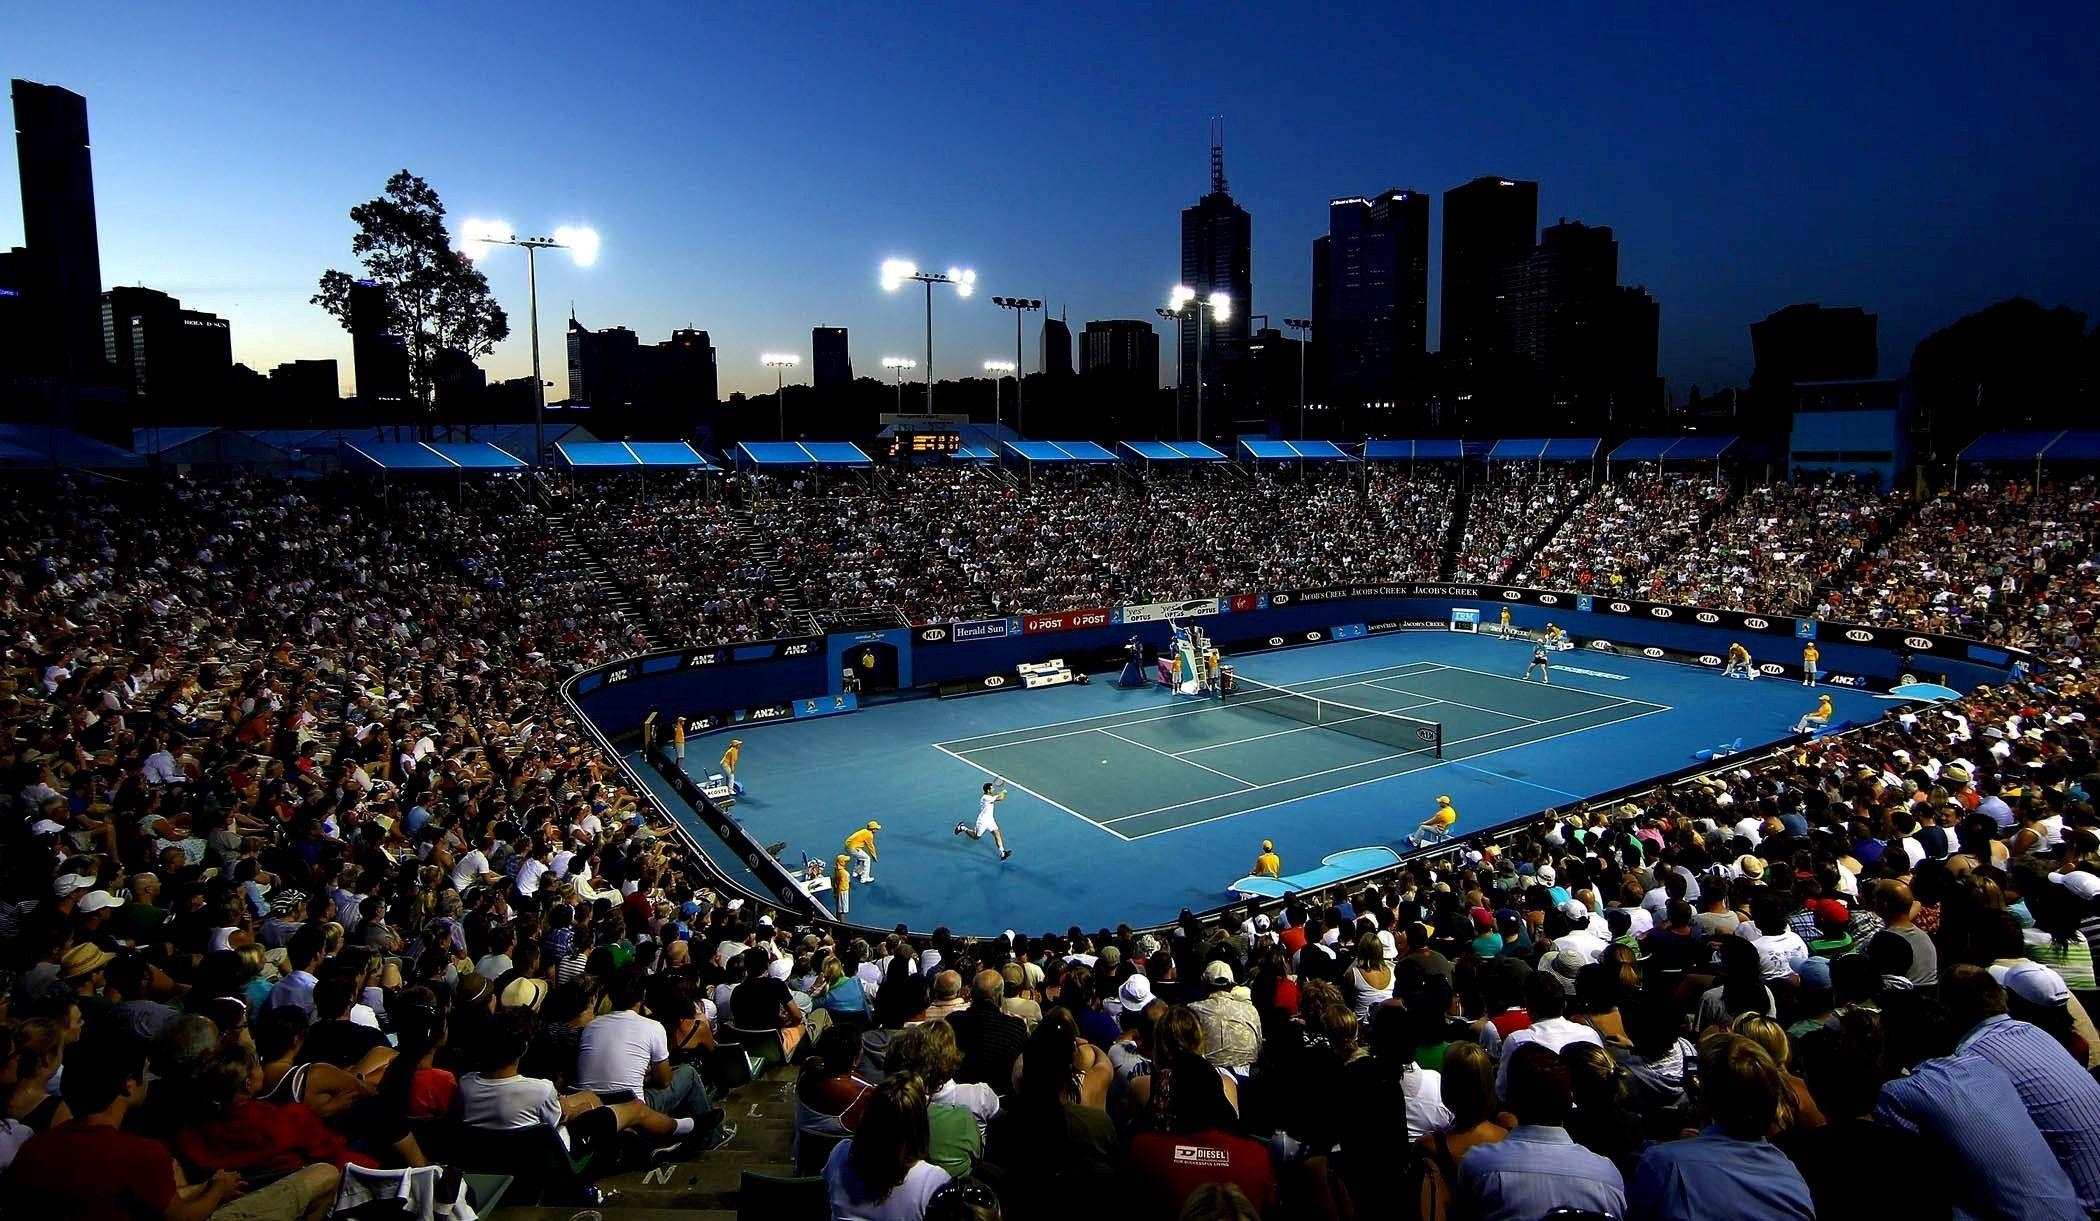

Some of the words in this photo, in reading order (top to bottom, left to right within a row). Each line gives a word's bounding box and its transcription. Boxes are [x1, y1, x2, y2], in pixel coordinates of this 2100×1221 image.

[1412, 585, 1448, 595] JACOB'S
[1448, 587, 1479, 596] CREEK
[1504, 591, 1520, 599] KIA
[1541, 594, 1556, 603] KIA
[1197, 607, 1216, 615] OPTUS
[1612, 602, 1630, 612] KIA
[1653, 607, 1672, 617] KIA
[1082, 615, 1105, 625] POST
[1130, 614, 1151, 622] OPTUS
[1697, 612, 1718, 622] KIA
[1039, 619, 1063, 630] POST
[1745, 618, 1767, 628] KIA
[925, 630, 943, 640] KIA
[956, 627, 986, 637] Herald
[987, 624, 1004, 634] Sun
[1847, 629, 1873, 640] KIA
[1905, 636, 1932, 648] KIA
[784, 644, 808, 656] ANZ
[1645, 647, 1663, 656] KIA
[690, 653, 715, 666] ANZ
[1701, 655, 1720, 664] KIA
[1762, 664, 1782, 673] KIA
[608, 668, 628, 683] ANZ
[1830, 675, 1855, 685] ANZ
[986, 678, 1003, 687] KIA
[753, 708, 775, 718] ANZ
[690, 719, 710, 730] ANZ
[1198, 1150, 1226, 1159] DIESEL
